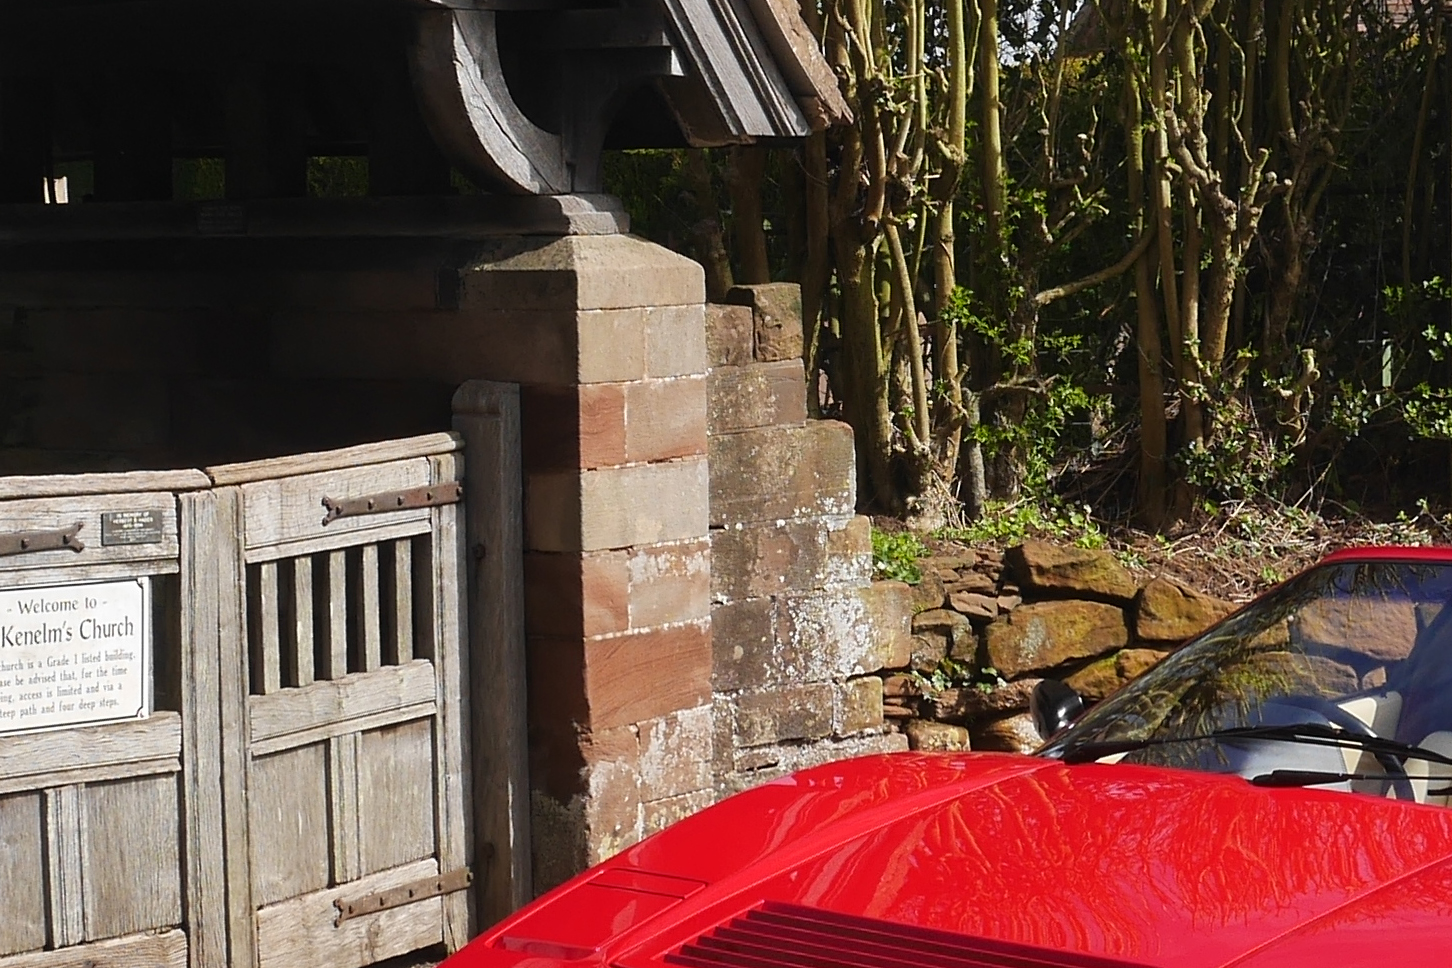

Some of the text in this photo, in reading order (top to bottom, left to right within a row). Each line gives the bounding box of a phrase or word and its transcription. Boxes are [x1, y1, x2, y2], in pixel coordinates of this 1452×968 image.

[18, 598, 78, 614] Welcome
[85, 597, 97, 610] to
[1, 616, 134, 648] Kenelm's Church
[28, 660, 34, 669] is
[47, 655, 70, 667] Grade
[82, 652, 101, 664] listed
[105, 648, 136, 662] building.
[15, 675, 24, 686] be
[28, 673, 56, 684] advised
[60, 670, 77, 681] that,
[82, 668, 93, 678] for
[96, 666, 108, 677] the
[112, 665, 128, 676] time
[19, 692, 42, 701] access
[46, 687, 52, 698] is
[57, 684, 82, 696] limited
[86, 682, 99, 693] and
[103, 680, 114, 691] via
[20, 704, 37, 718] path
[41, 702, 55, 714] and
[59, 701, 74, 712] four
[78, 699, 96, 711] deep
[100, 698, 120, 709] steps.
